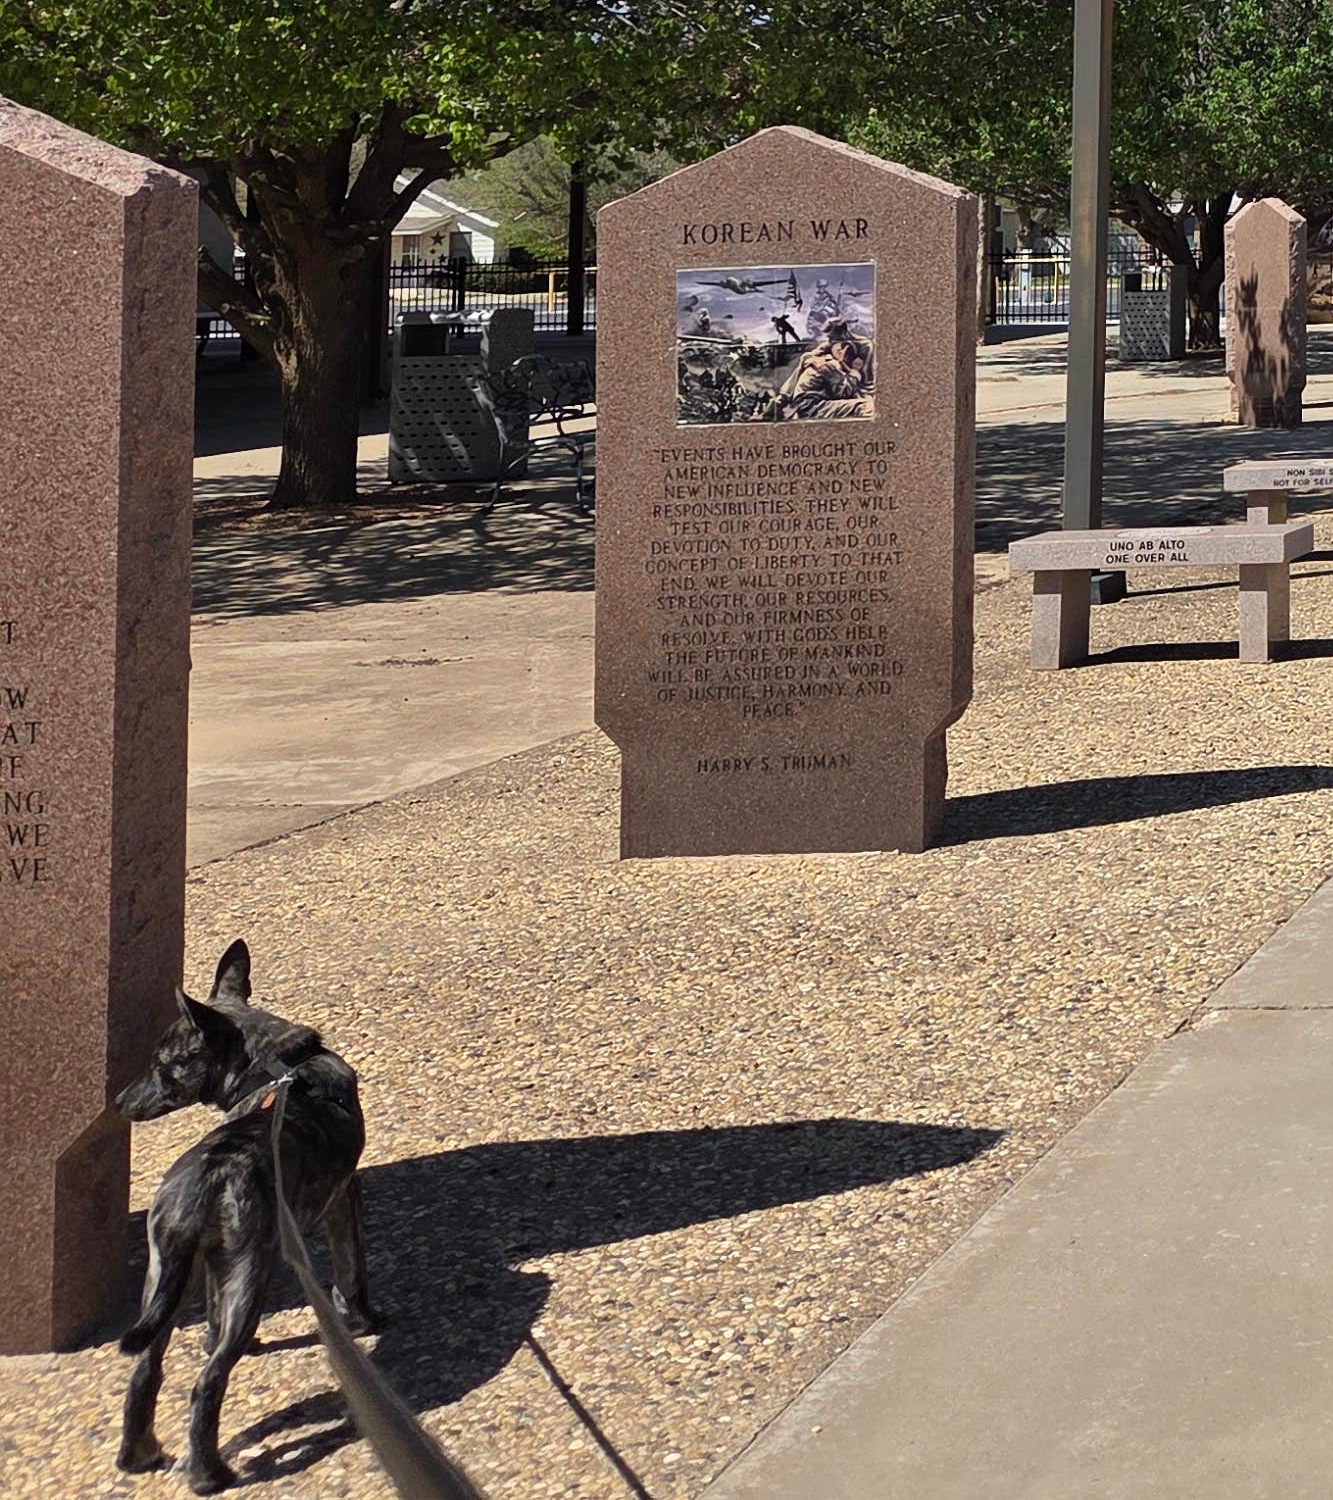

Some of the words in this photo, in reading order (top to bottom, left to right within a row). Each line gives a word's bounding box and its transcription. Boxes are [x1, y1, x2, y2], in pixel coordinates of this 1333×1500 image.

[682, 220, 795, 245] KOREAN
[810, 218, 870, 241] WAR
[732, 445, 775, 461] HAVE
[782, 443, 858, 459] BROUGHT
[864, 442, 897, 456] OUR
[664, 466, 749, 483] AMERICAN
[758, 461, 859, 479] DEMOCRACY
[867, 460, 888, 475] TO
[1287, 469, 1305, 477] NON
[665, 484, 698, 500] NEW
[708, 481, 798, 498] INFLUENCE
[807, 480, 842, 494] AND
[851, 479, 885, 493] NEW
[807, 499, 849, 513] THEY
[859, 497, 899, 511] WILL
[671, 521, 712, 535] TEST
[719, 520, 751, 534] OUR
[847, 516, 879, 529] OUR
[651, 540, 731, 555] DEVOTION
[742, 538, 761, 552] TO
[824, 534, 858, 548] AND
[866, 533, 898, 547] OUR
[1110, 541, 1134, 551] UNO
[1139, 541, 1154, 550] AB
[1159, 540, 1185, 550] ALTO
[645, 558, 718, 574] CONCEPT
[728, 557, 747, 571] OF
[831, 553, 851, 567] TO
[859, 551, 902, 566] THAT
[1105, 554, 1130, 564] ONE
[1135, 553, 1165, 563] OVER
[1170, 553, 1189, 562] ALL
[706, 576, 729, 589] WE
[739, 574, 778, 588] WILL
[786, 572, 847, 587] DEVOTE
[856, 571, 888, 584] OUR
[755, 593, 792, 608] OUR
[680, 613, 716, 628] AND
[723, 612, 755, 626] OUR
[763, 609, 844, 625] FIRMNESS
[851, 608, 869, 621] OF
[743, 629, 786, 644] WITH
[665, 651, 698, 666] THE
[705, 649, 774, 663] FUTURE
[779, 648, 799, 663] OF
[805, 644, 886, 661] MANKIND
[648, 669, 688, 684] WILL
[695, 670, 711, 683] BE
[722, 666, 796, 683] ASSURED
[801, 665, 820, 680] IN
[828, 665, 839, 678] A
[849, 662, 904, 677] WORLD
[657, 688, 677, 703] OF
[855, 681, 891, 696] AND
[698, 756, 751, 774] HARRY
[782, 754, 852, 771] TRUMAN
